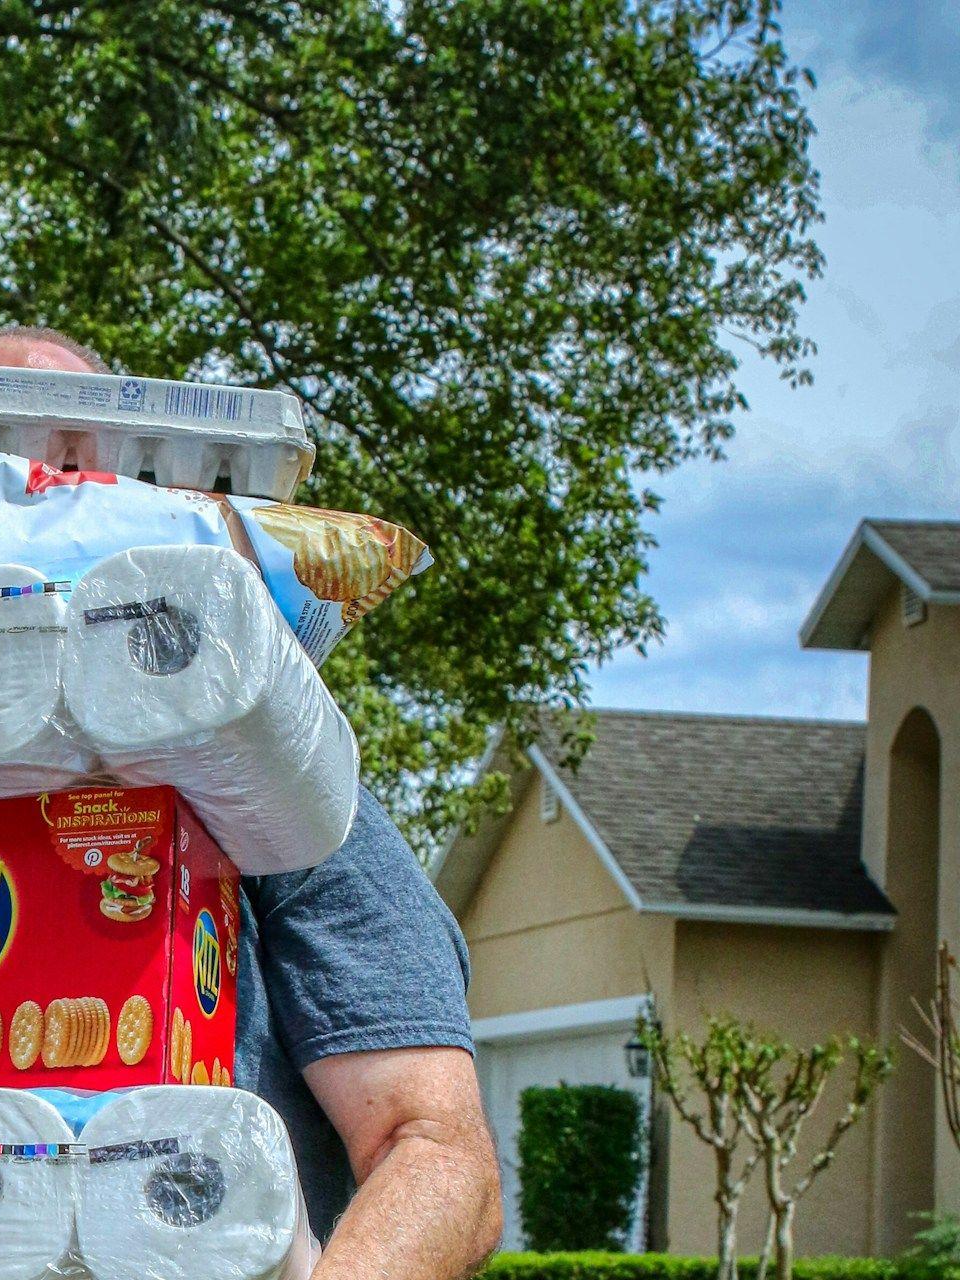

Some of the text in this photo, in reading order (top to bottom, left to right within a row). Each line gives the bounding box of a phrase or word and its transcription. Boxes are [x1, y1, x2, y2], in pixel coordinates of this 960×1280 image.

[94, 791, 113, 799] panel
[74, 799, 118, 814] Snack
[57, 810, 160, 828] INSPIRATIONS!
